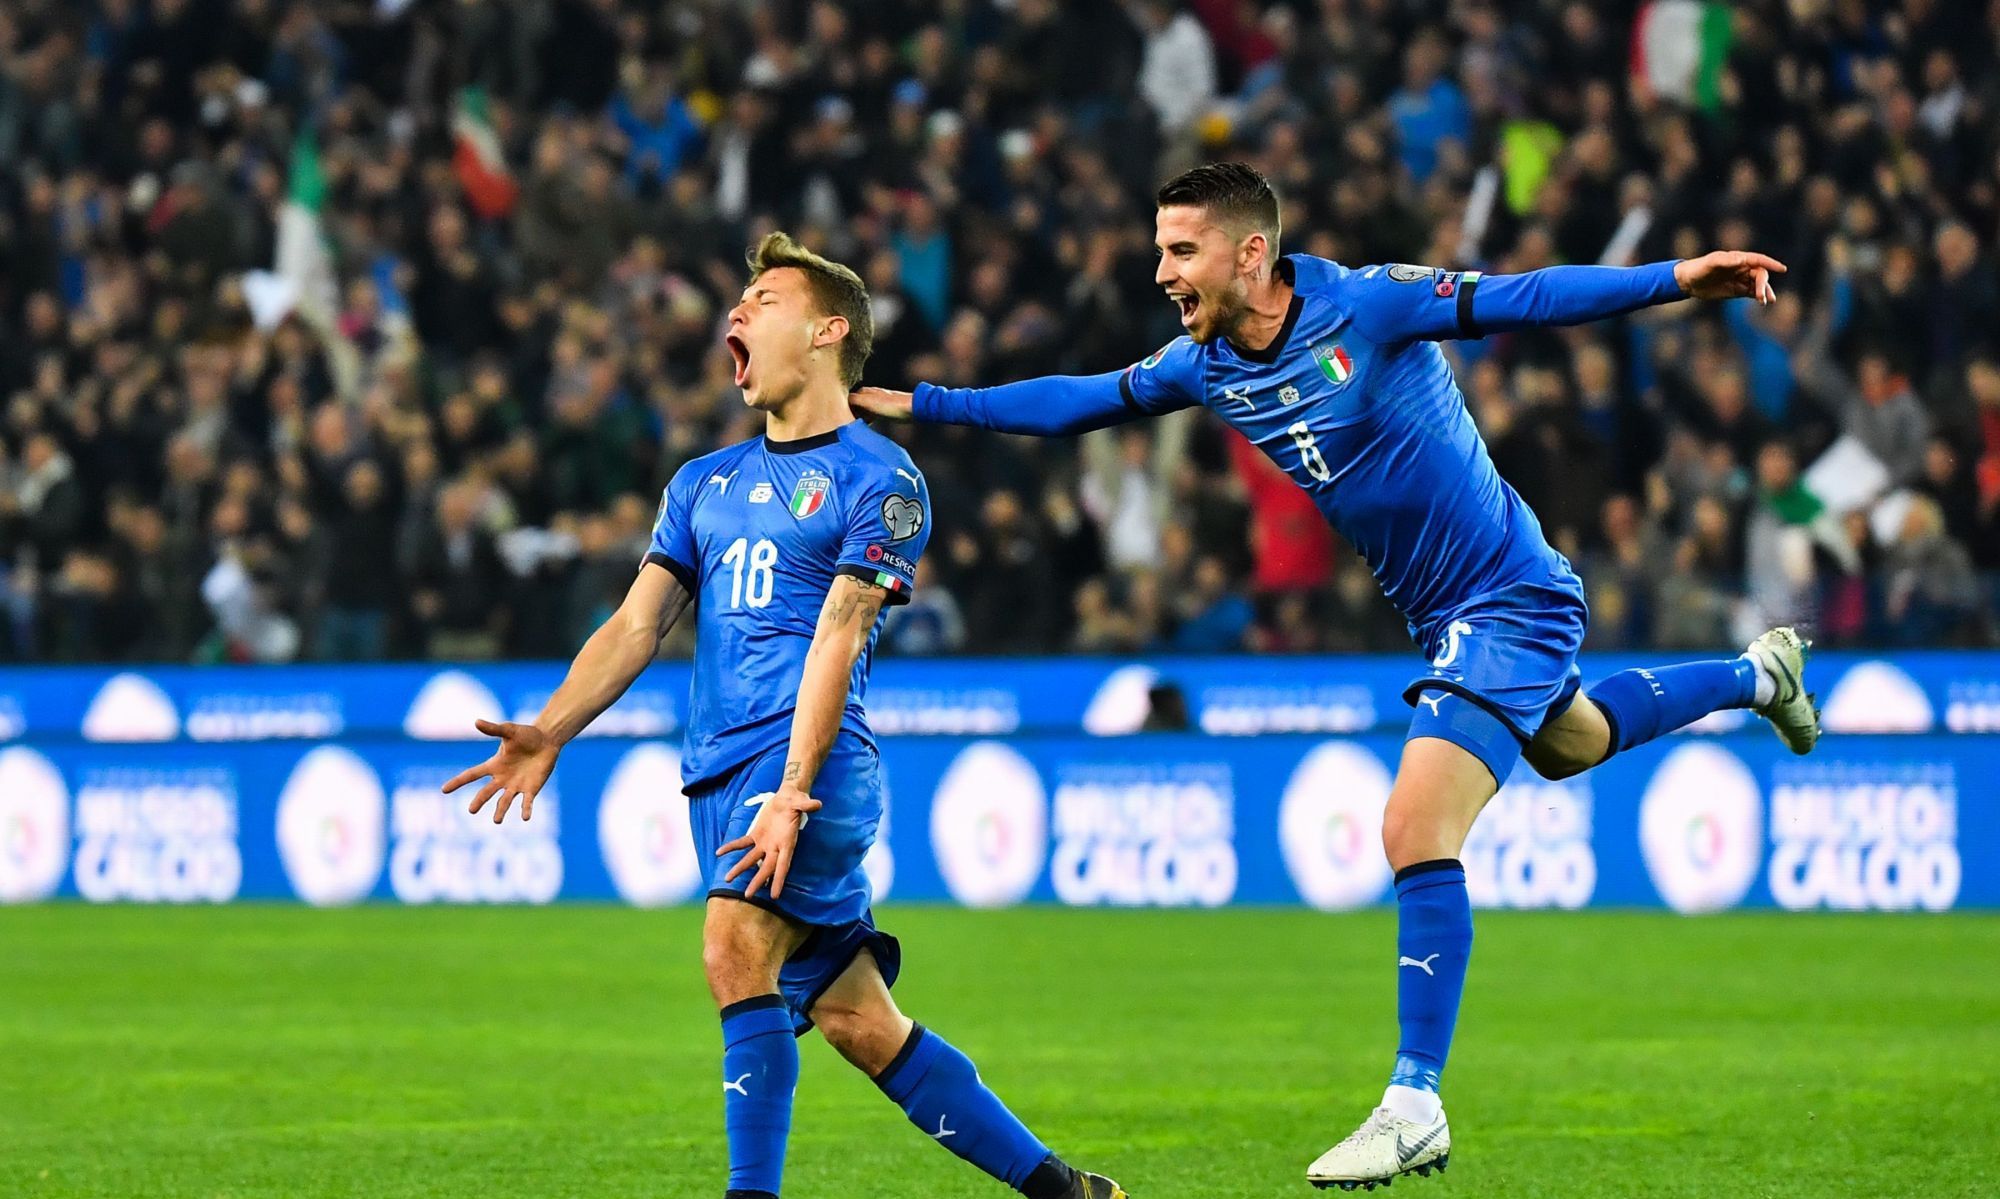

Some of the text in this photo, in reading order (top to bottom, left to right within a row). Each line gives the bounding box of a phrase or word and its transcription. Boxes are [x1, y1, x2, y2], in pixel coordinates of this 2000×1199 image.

[1288, 421, 1331, 482] 8
[799, 480, 827, 488] ITALIA
[722, 538, 778, 608] 18
[882, 552, 916, 577] RESPECT
[1767, 839, 1962, 910] CALCIO
